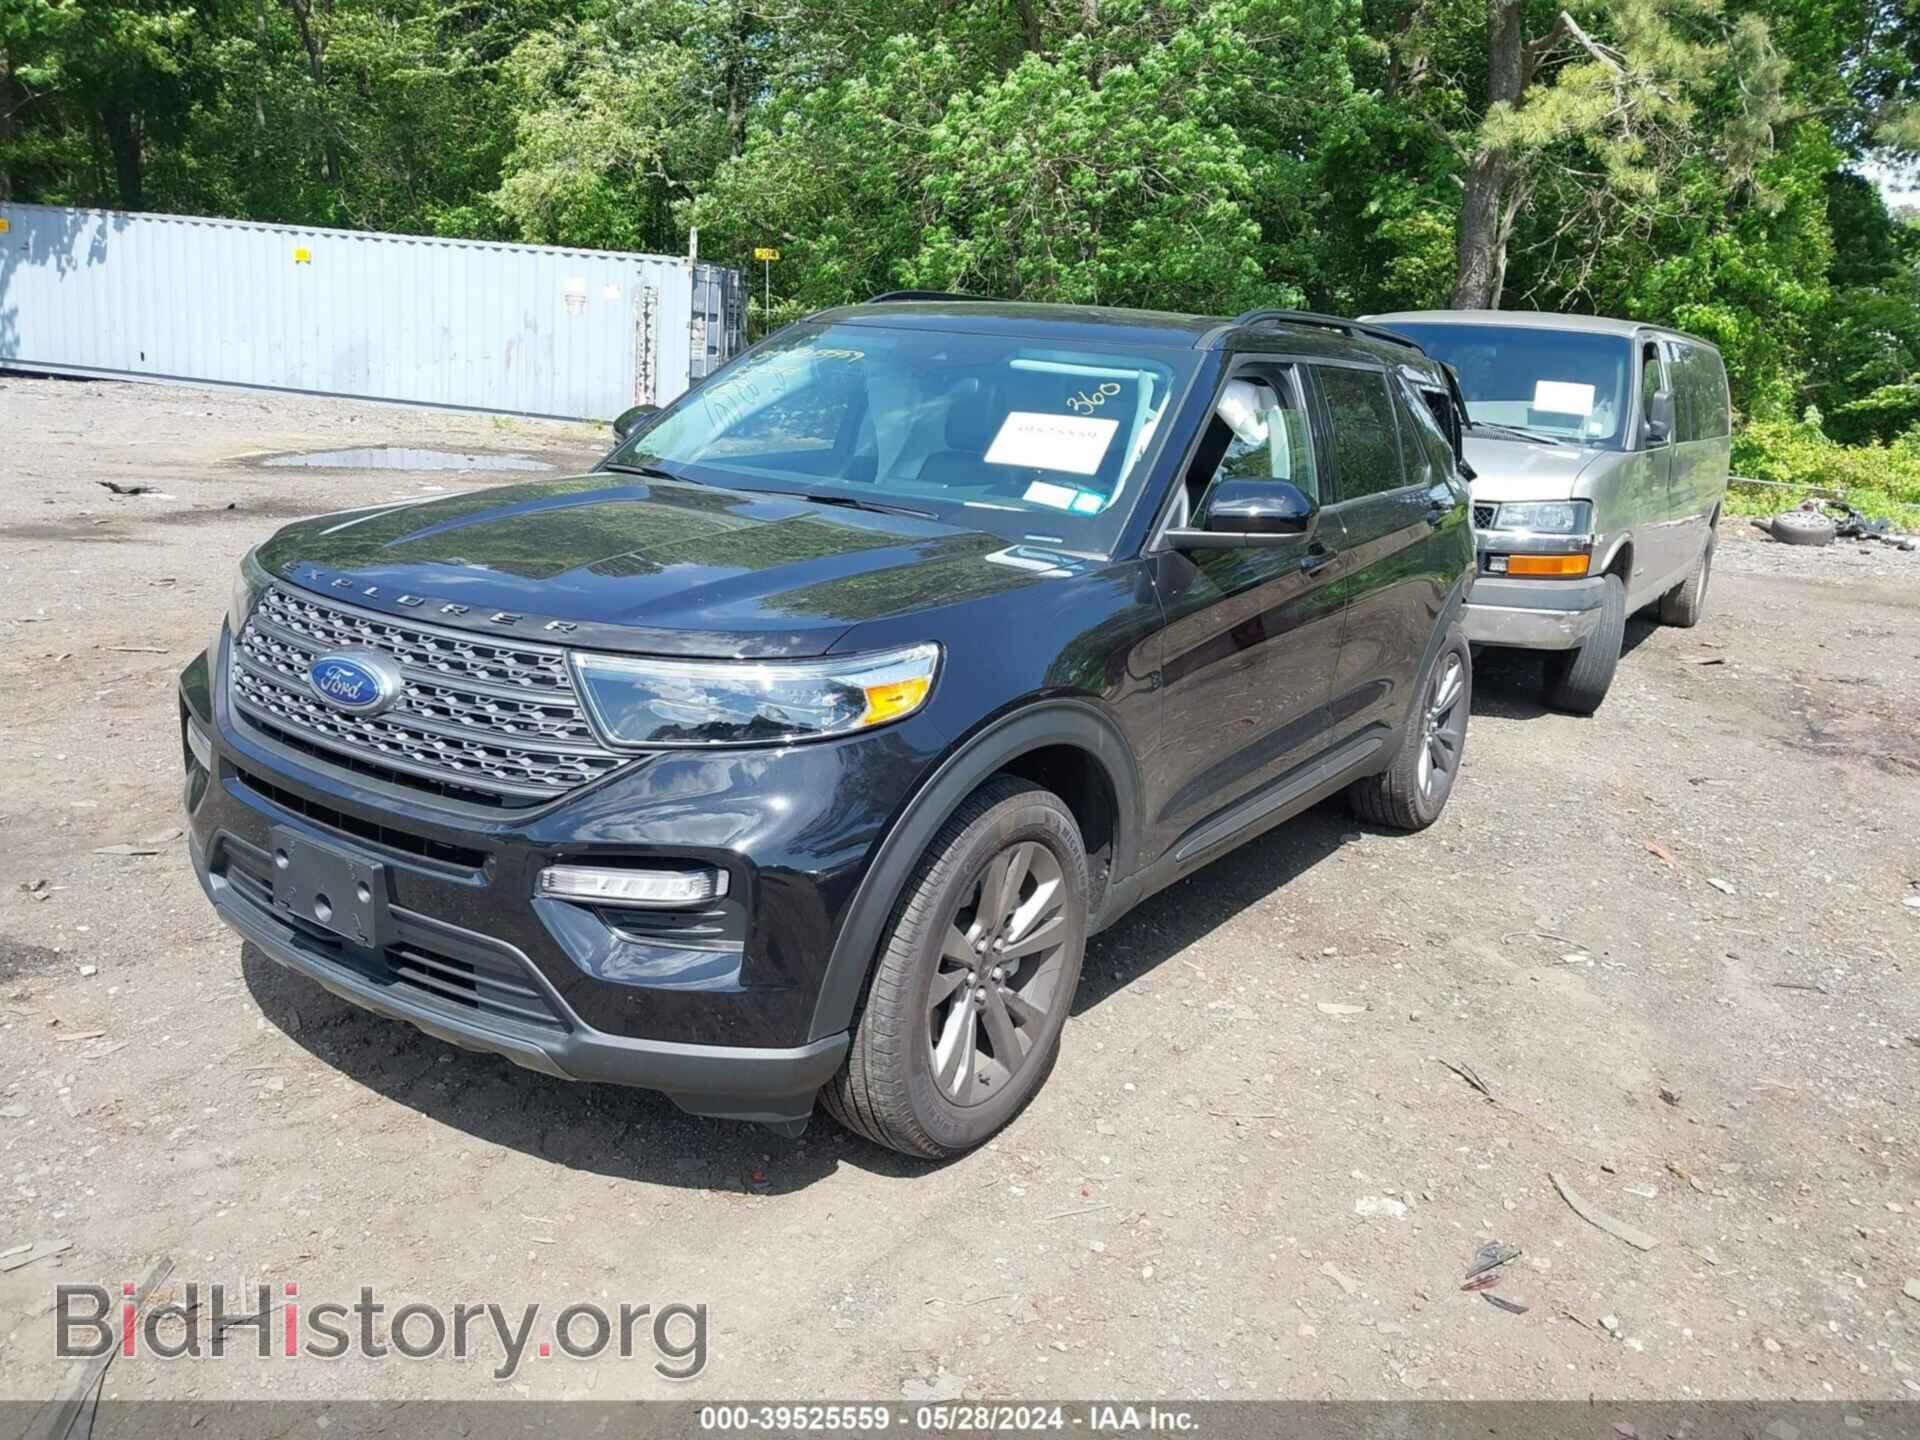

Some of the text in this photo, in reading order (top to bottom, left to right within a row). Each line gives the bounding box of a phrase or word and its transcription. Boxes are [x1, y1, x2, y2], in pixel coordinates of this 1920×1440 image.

[1066, 383, 1121, 416] 360
[281, 562, 578, 634] EXPLORER
[320, 665, 362, 699] Ford
